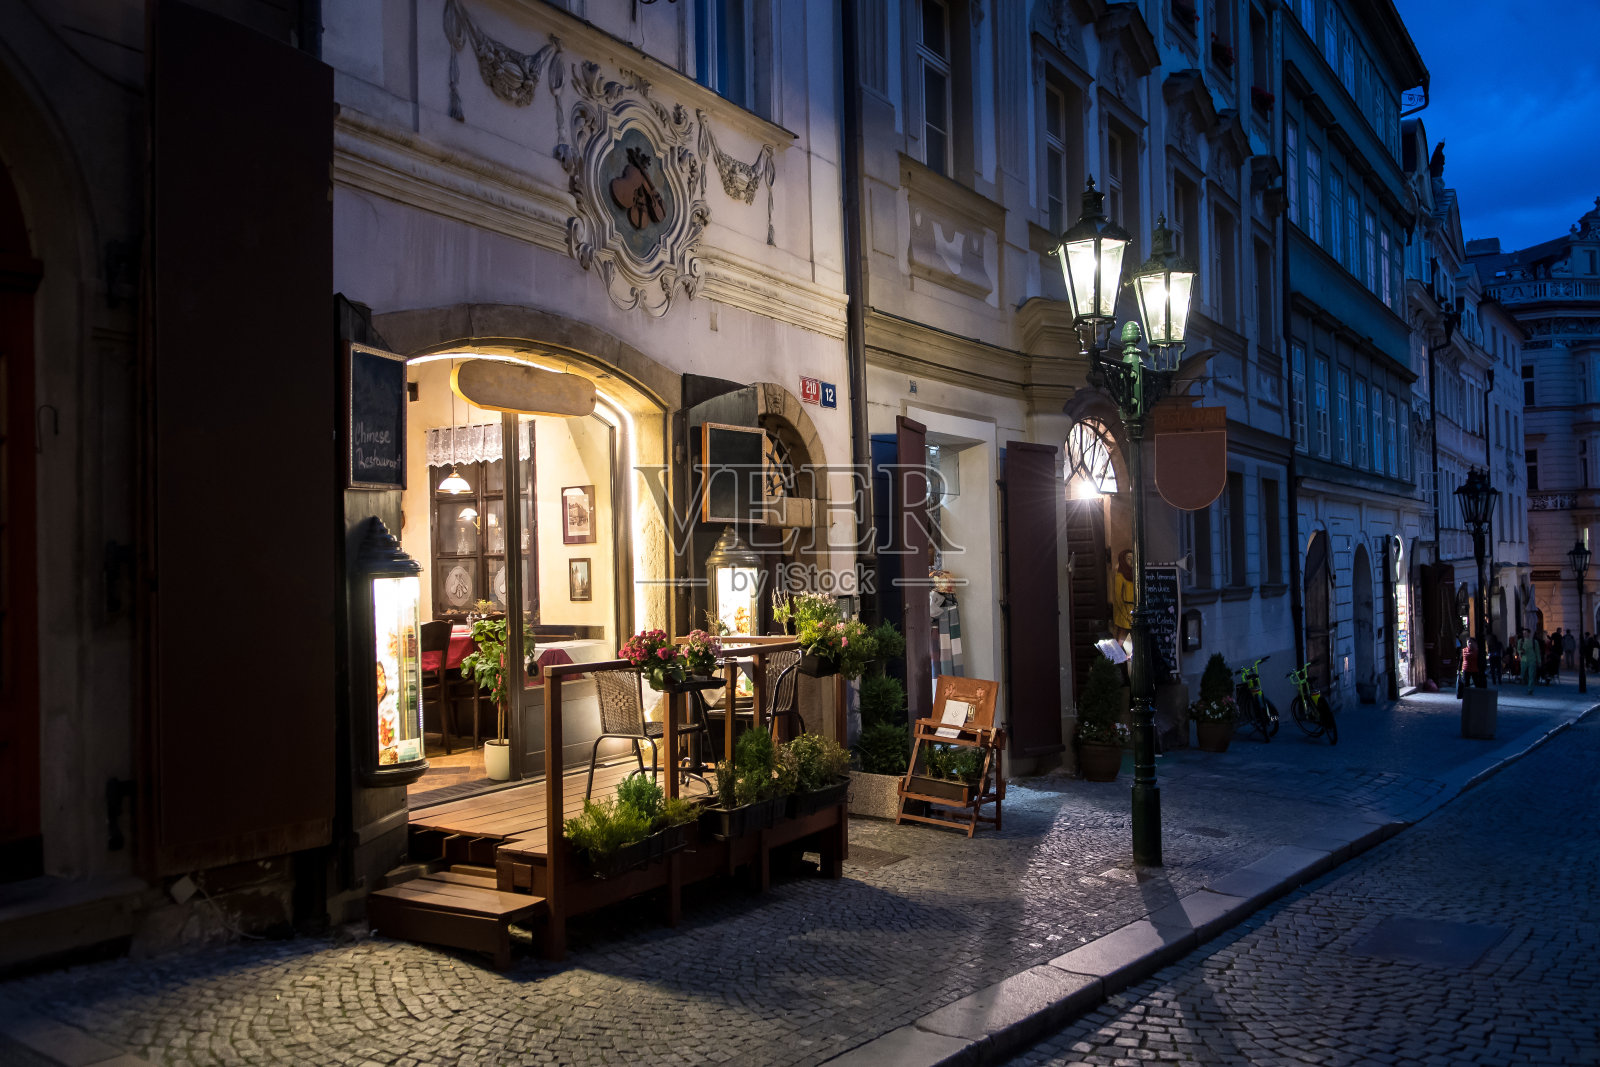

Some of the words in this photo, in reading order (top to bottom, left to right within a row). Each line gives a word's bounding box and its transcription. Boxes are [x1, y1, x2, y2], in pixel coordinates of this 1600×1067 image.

[805, 381, 817, 395] 210
[825, 388, 834, 402] 12
[354, 421, 391, 445] Chinese
